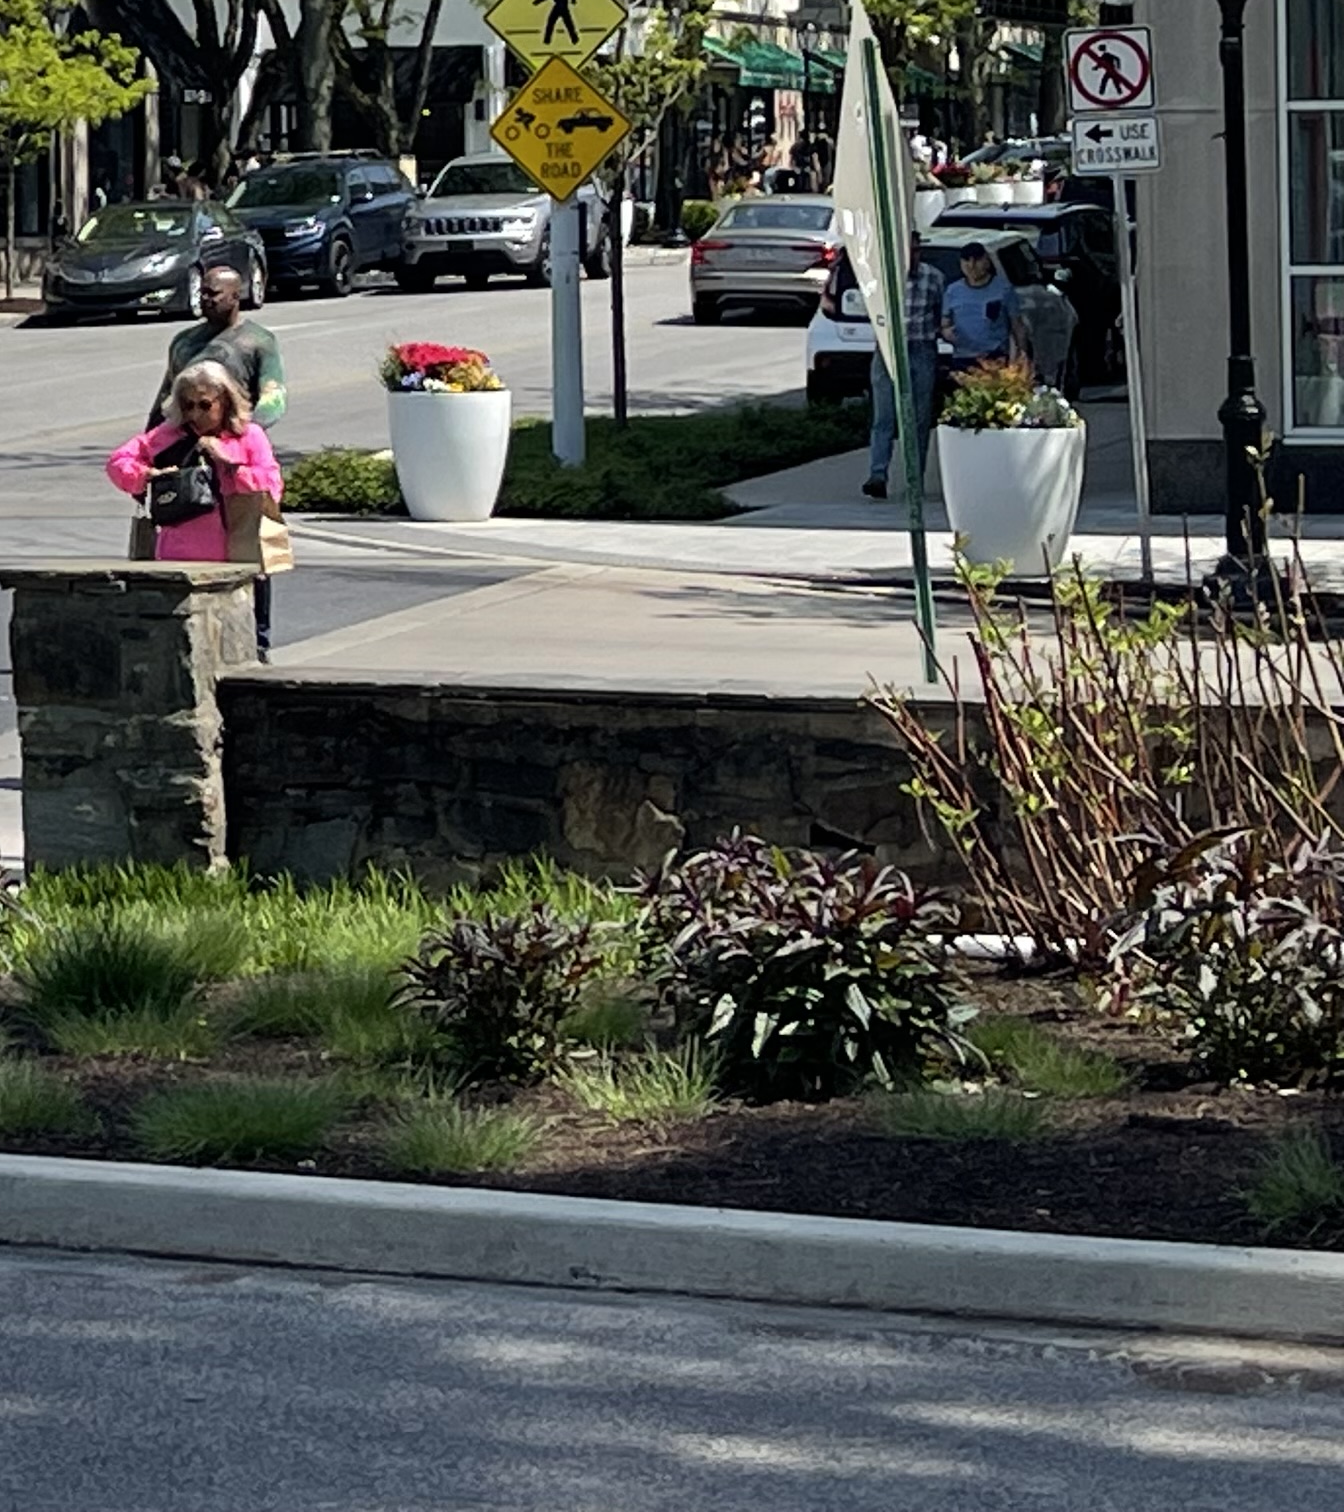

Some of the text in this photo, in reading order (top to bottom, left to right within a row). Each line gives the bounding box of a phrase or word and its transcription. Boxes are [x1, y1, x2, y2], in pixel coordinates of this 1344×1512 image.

[532, 86, 584, 104] SHARE
[1119, 122, 1150, 141] USE
[545, 142, 574, 159] THE
[1076, 146, 1157, 165] CROSSWALK
[540, 161, 582, 179] ROAD
